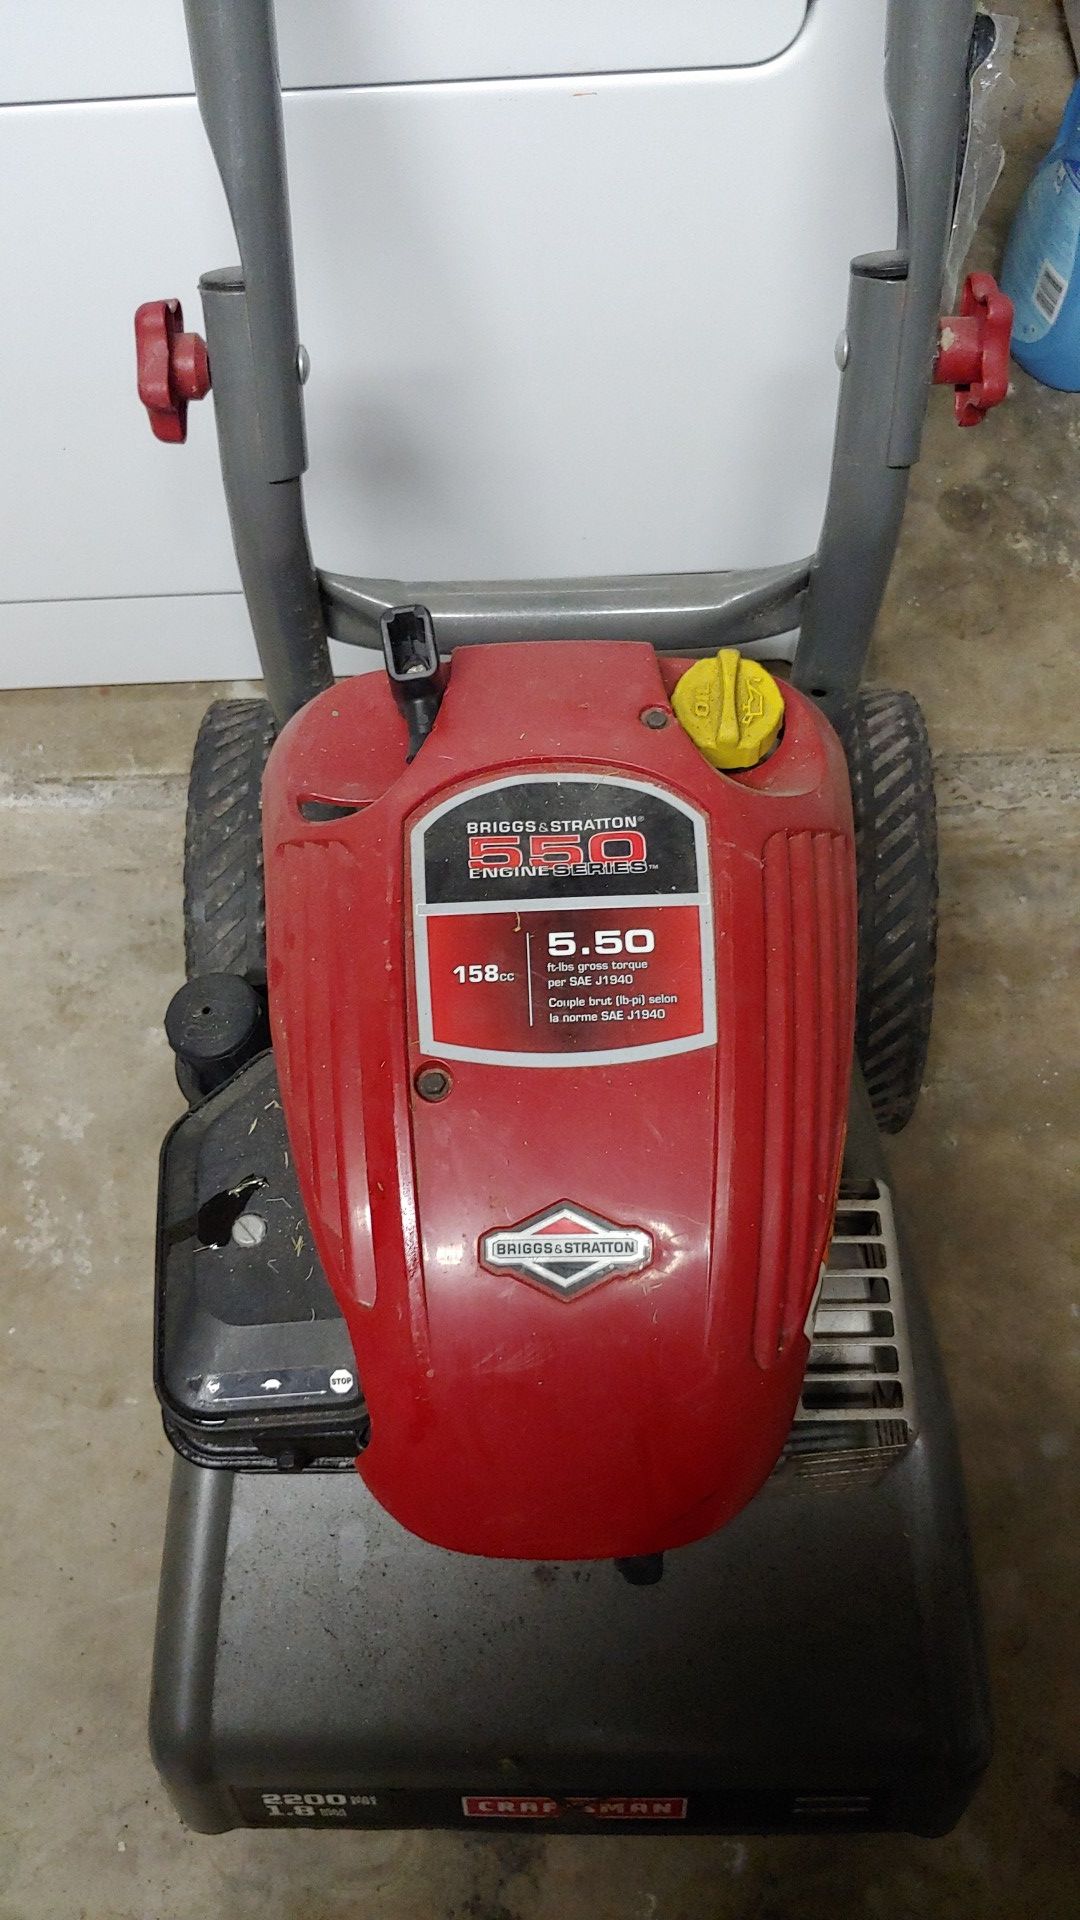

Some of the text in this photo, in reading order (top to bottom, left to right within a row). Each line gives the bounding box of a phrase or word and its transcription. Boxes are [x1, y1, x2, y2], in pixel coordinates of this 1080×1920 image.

[468, 830, 647, 869] 550
[469, 866, 550, 879] ENGINE
[548, 928, 655, 957] 5.50
[547, 960, 648, 974] ft-lbs gross torque
[548, 974, 634, 989] per SAE J1940
[548, 993, 678, 1010] Couple brut (lb-pi) selon
[549, 1008, 666, 1023] la norme SAE J1940
[331, 1376, 352, 1386] STOP
[261, 1793, 347, 1806] 2200
[266, 1805, 316, 1817] 1.8
